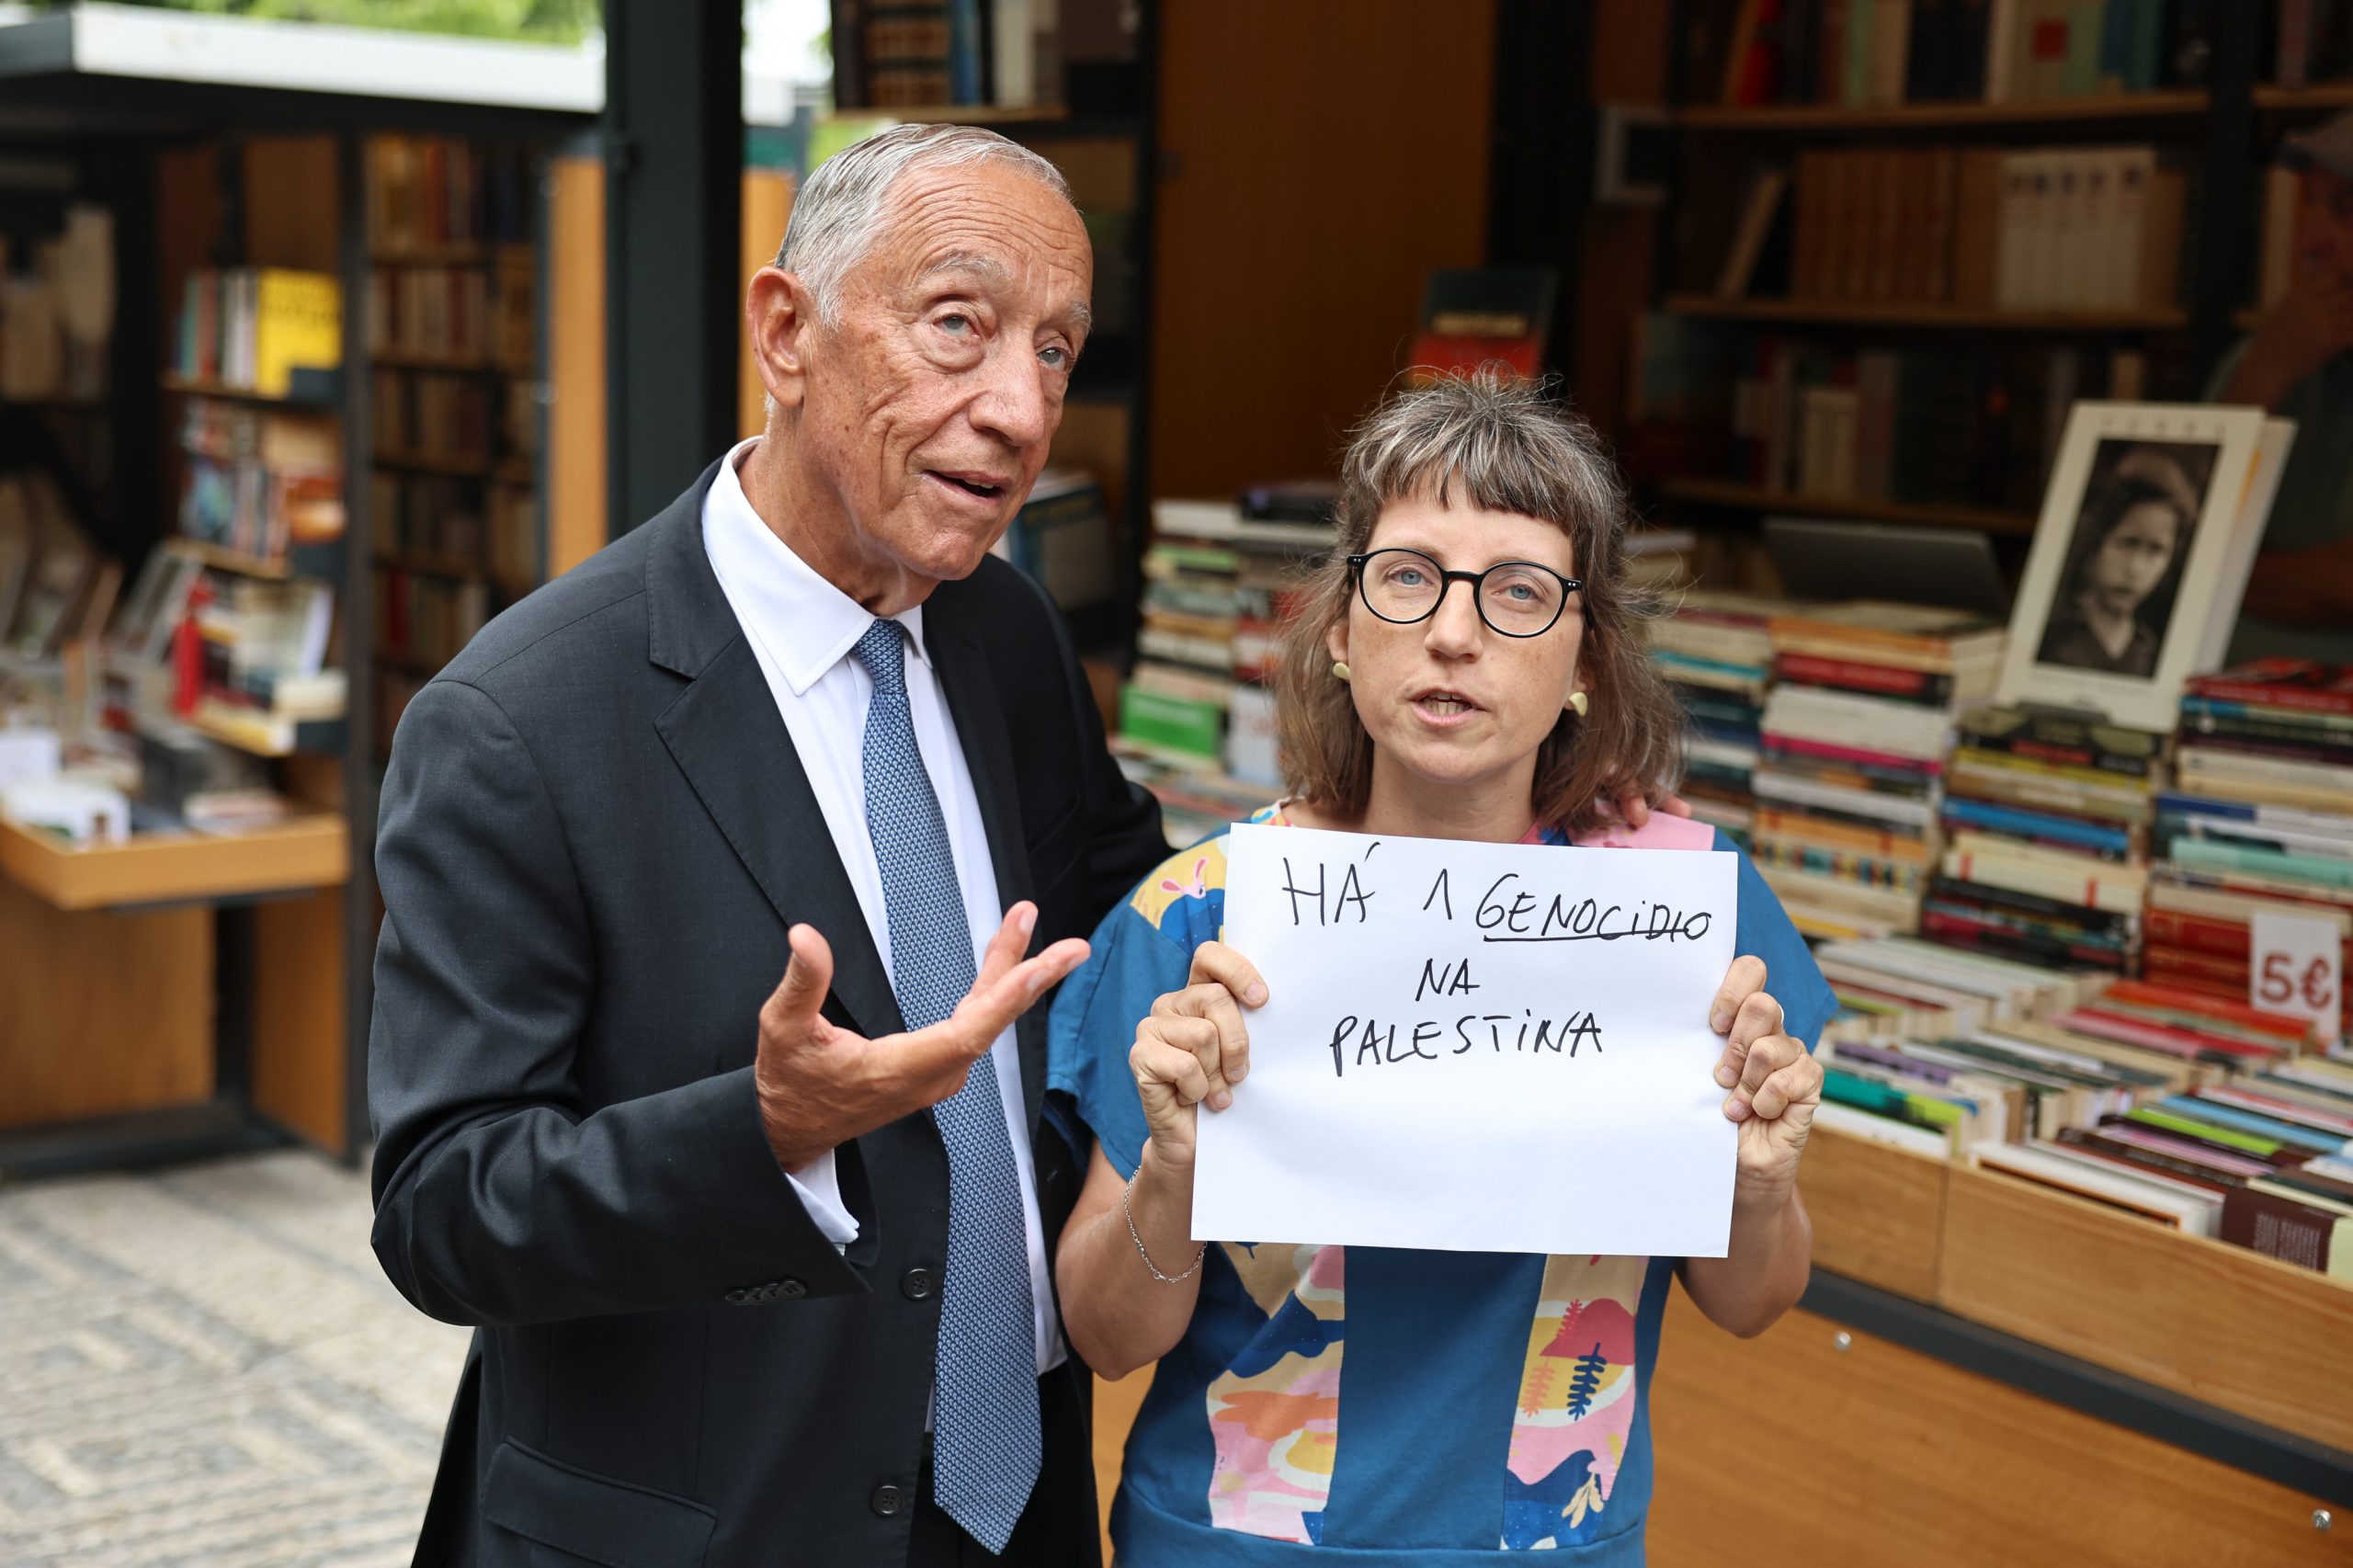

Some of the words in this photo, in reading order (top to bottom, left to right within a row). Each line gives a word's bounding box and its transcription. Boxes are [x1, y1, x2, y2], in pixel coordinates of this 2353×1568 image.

[1282, 841, 1381, 926] HÁ
[1422, 868, 1452, 921] 1
[1415, 958, 1481, 1002] NA
[2260, 953, 2332, 1010] 5€
